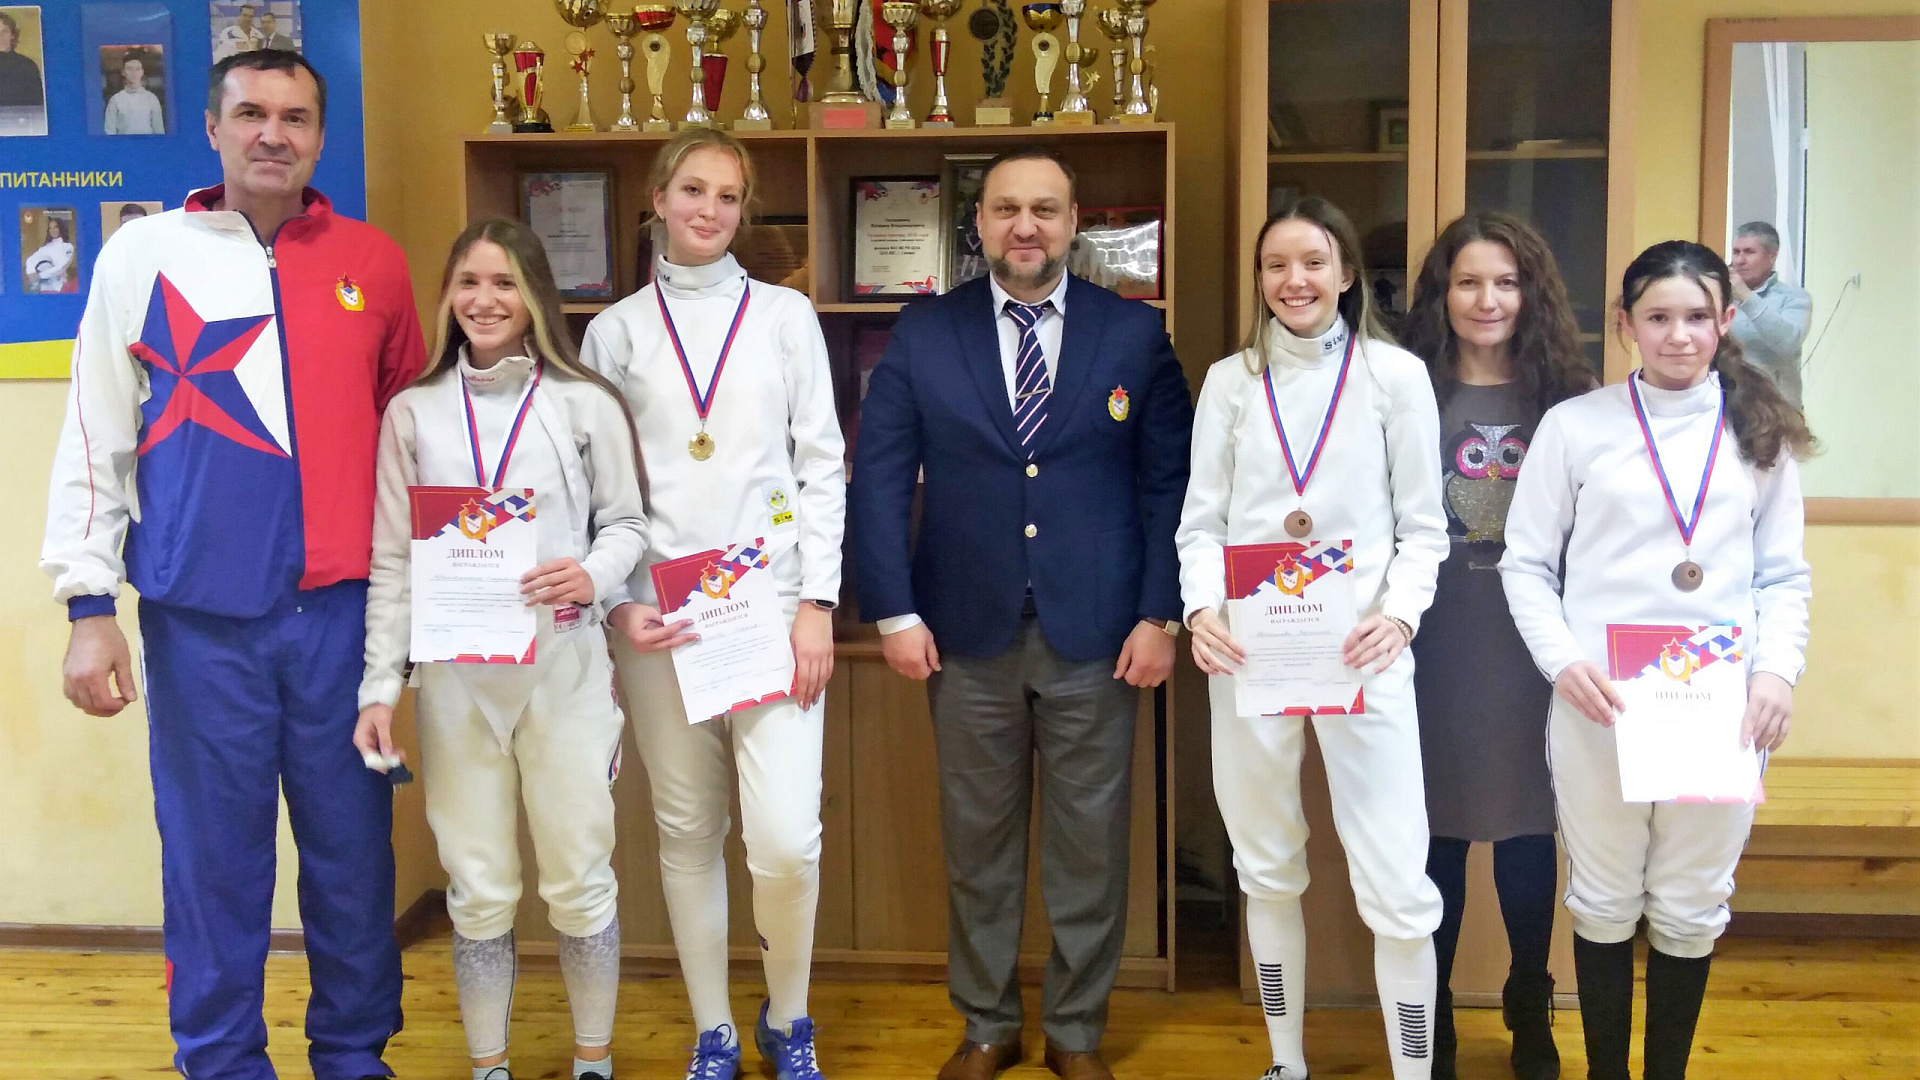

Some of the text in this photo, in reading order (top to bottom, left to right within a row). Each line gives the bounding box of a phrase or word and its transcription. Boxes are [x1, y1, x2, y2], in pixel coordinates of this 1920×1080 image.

[0, 171, 122, 188] ПИТАННИКИ
[447, 548, 504, 559] ДИПЛОМ
[698, 600, 750, 622] ДИПЛОМ
[1265, 603, 1323, 616] ДИПЛОМ
